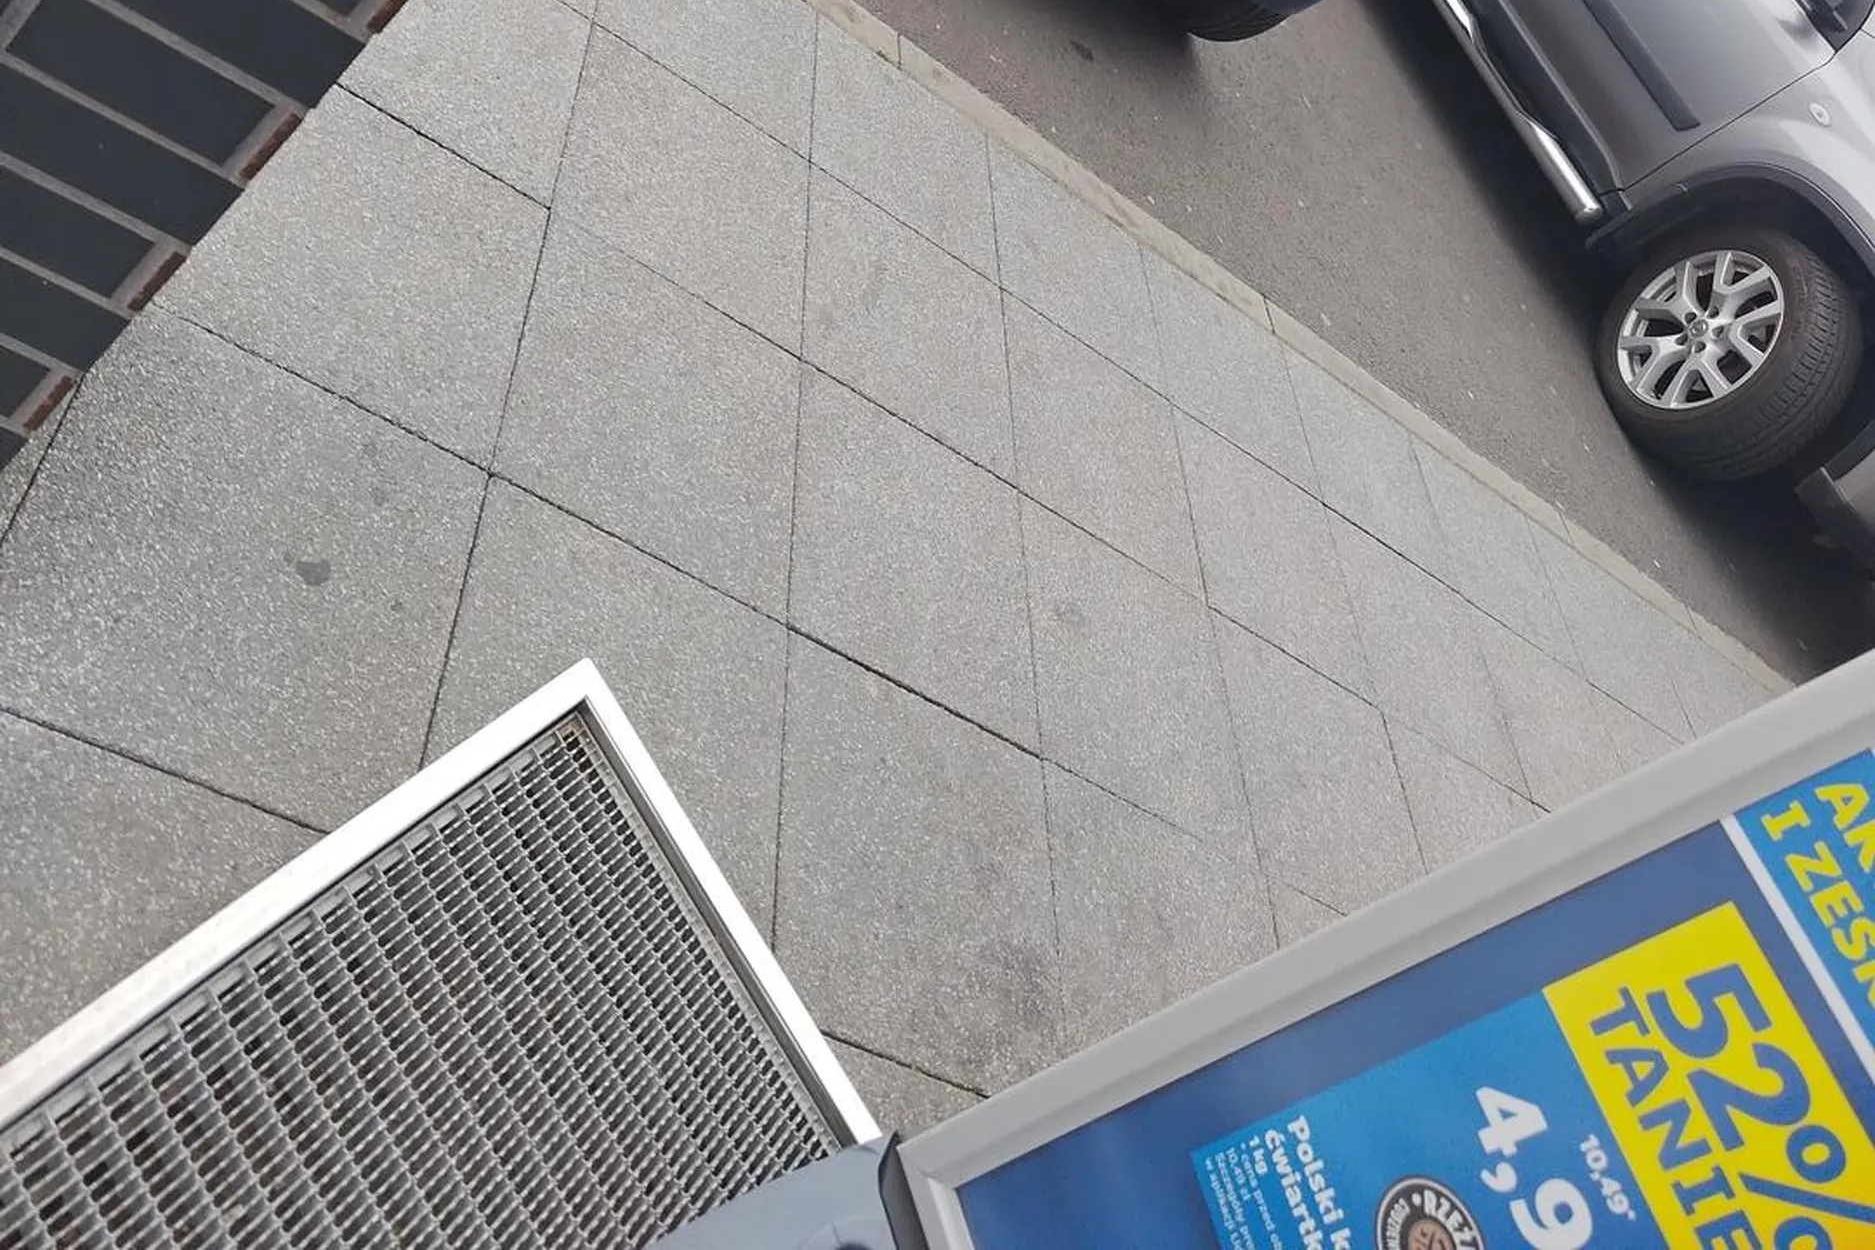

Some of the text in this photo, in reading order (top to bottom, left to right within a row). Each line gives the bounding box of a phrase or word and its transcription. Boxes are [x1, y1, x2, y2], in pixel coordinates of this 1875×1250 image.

[1761, 799, 1812, 841] I
[1249, 1135, 1268, 1175] 1 kg
[1287, 1114, 1345, 1225] Polski
[1253, 1188, 1276, 1231] przed
